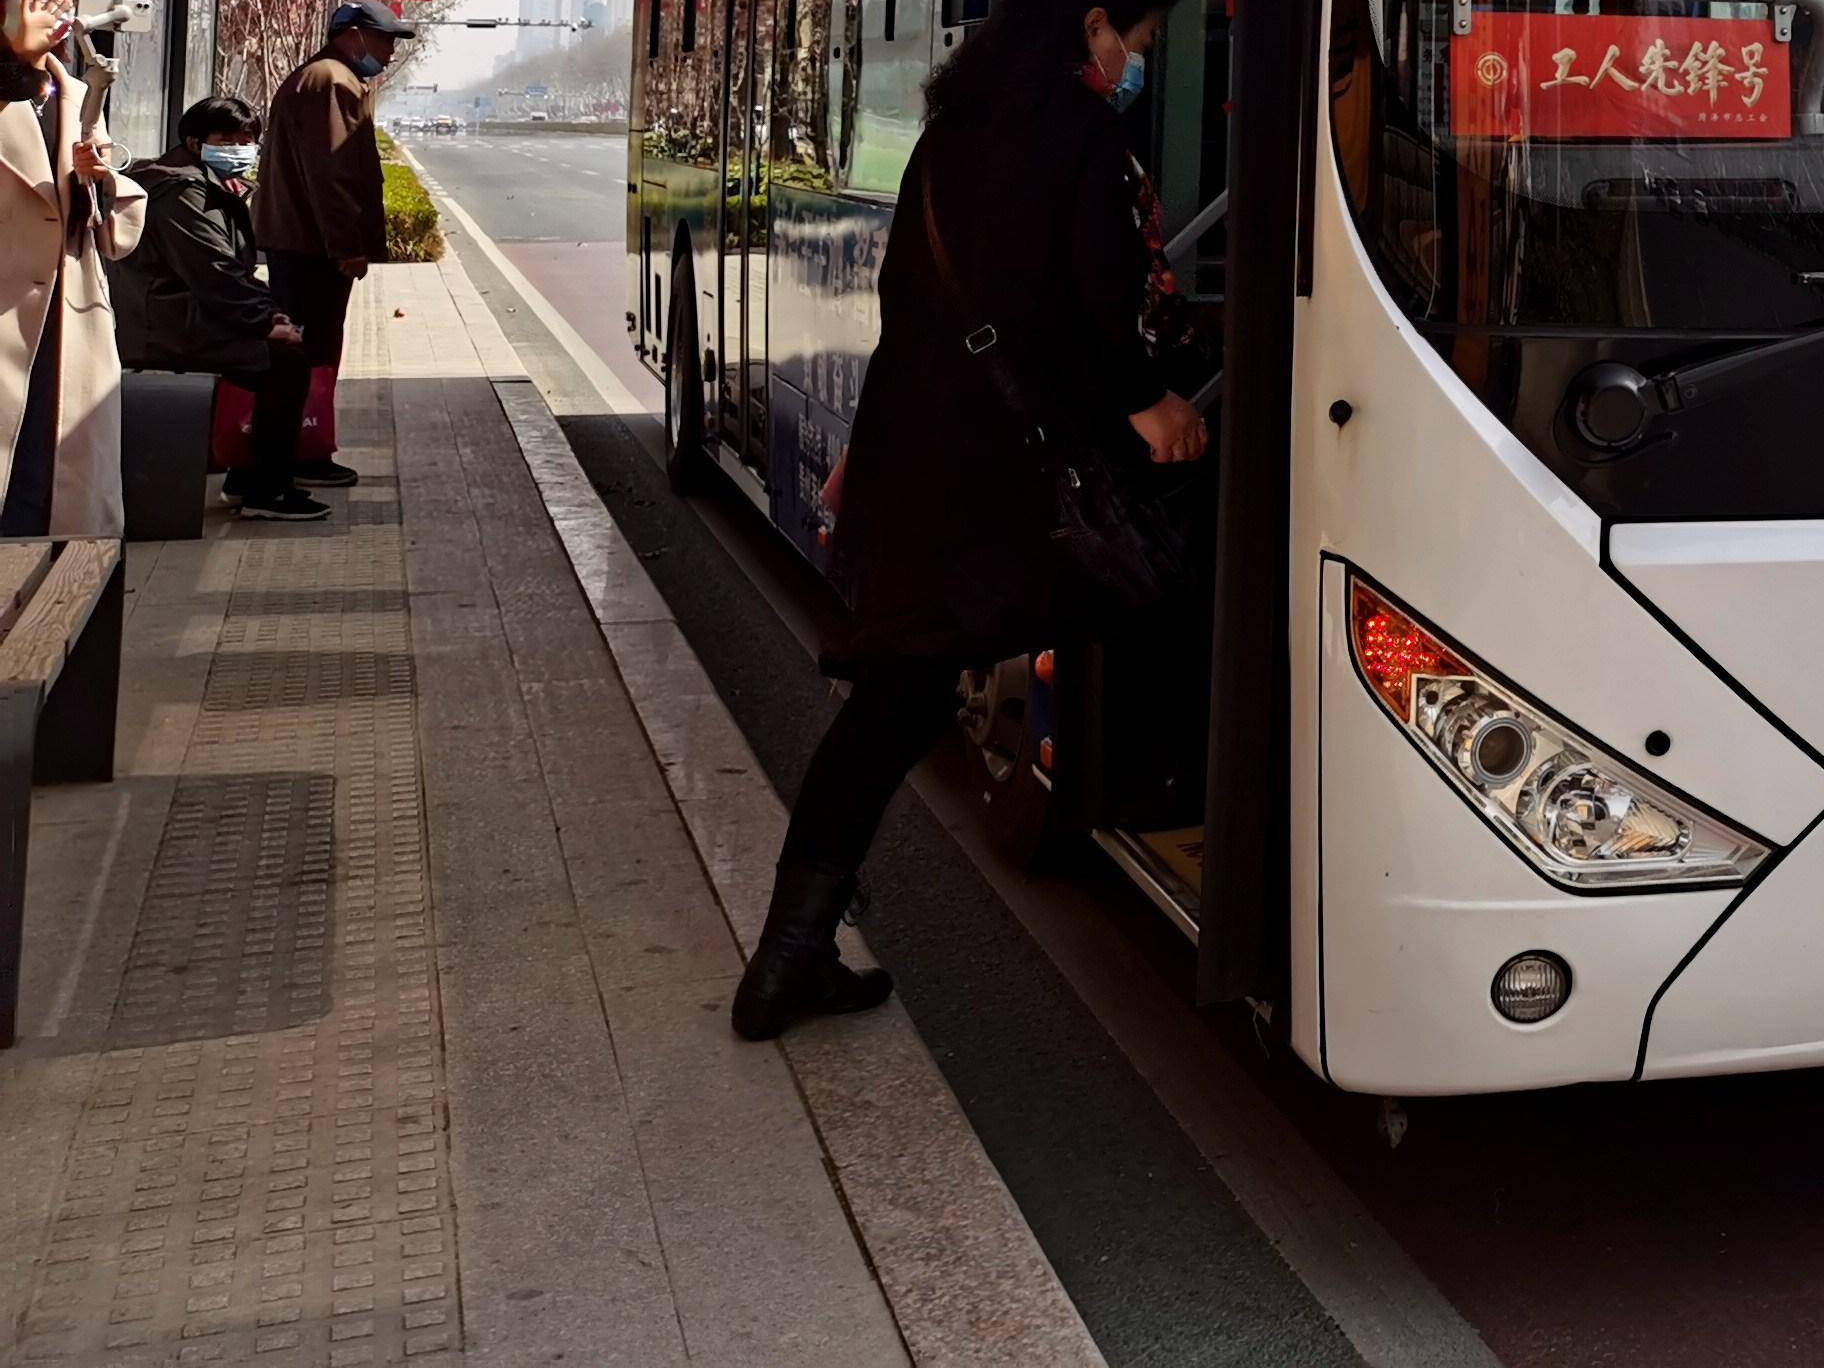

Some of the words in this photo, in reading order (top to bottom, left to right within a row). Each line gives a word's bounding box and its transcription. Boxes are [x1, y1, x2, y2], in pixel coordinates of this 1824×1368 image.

[1540, 38, 1768, 109] 工人先锋号
